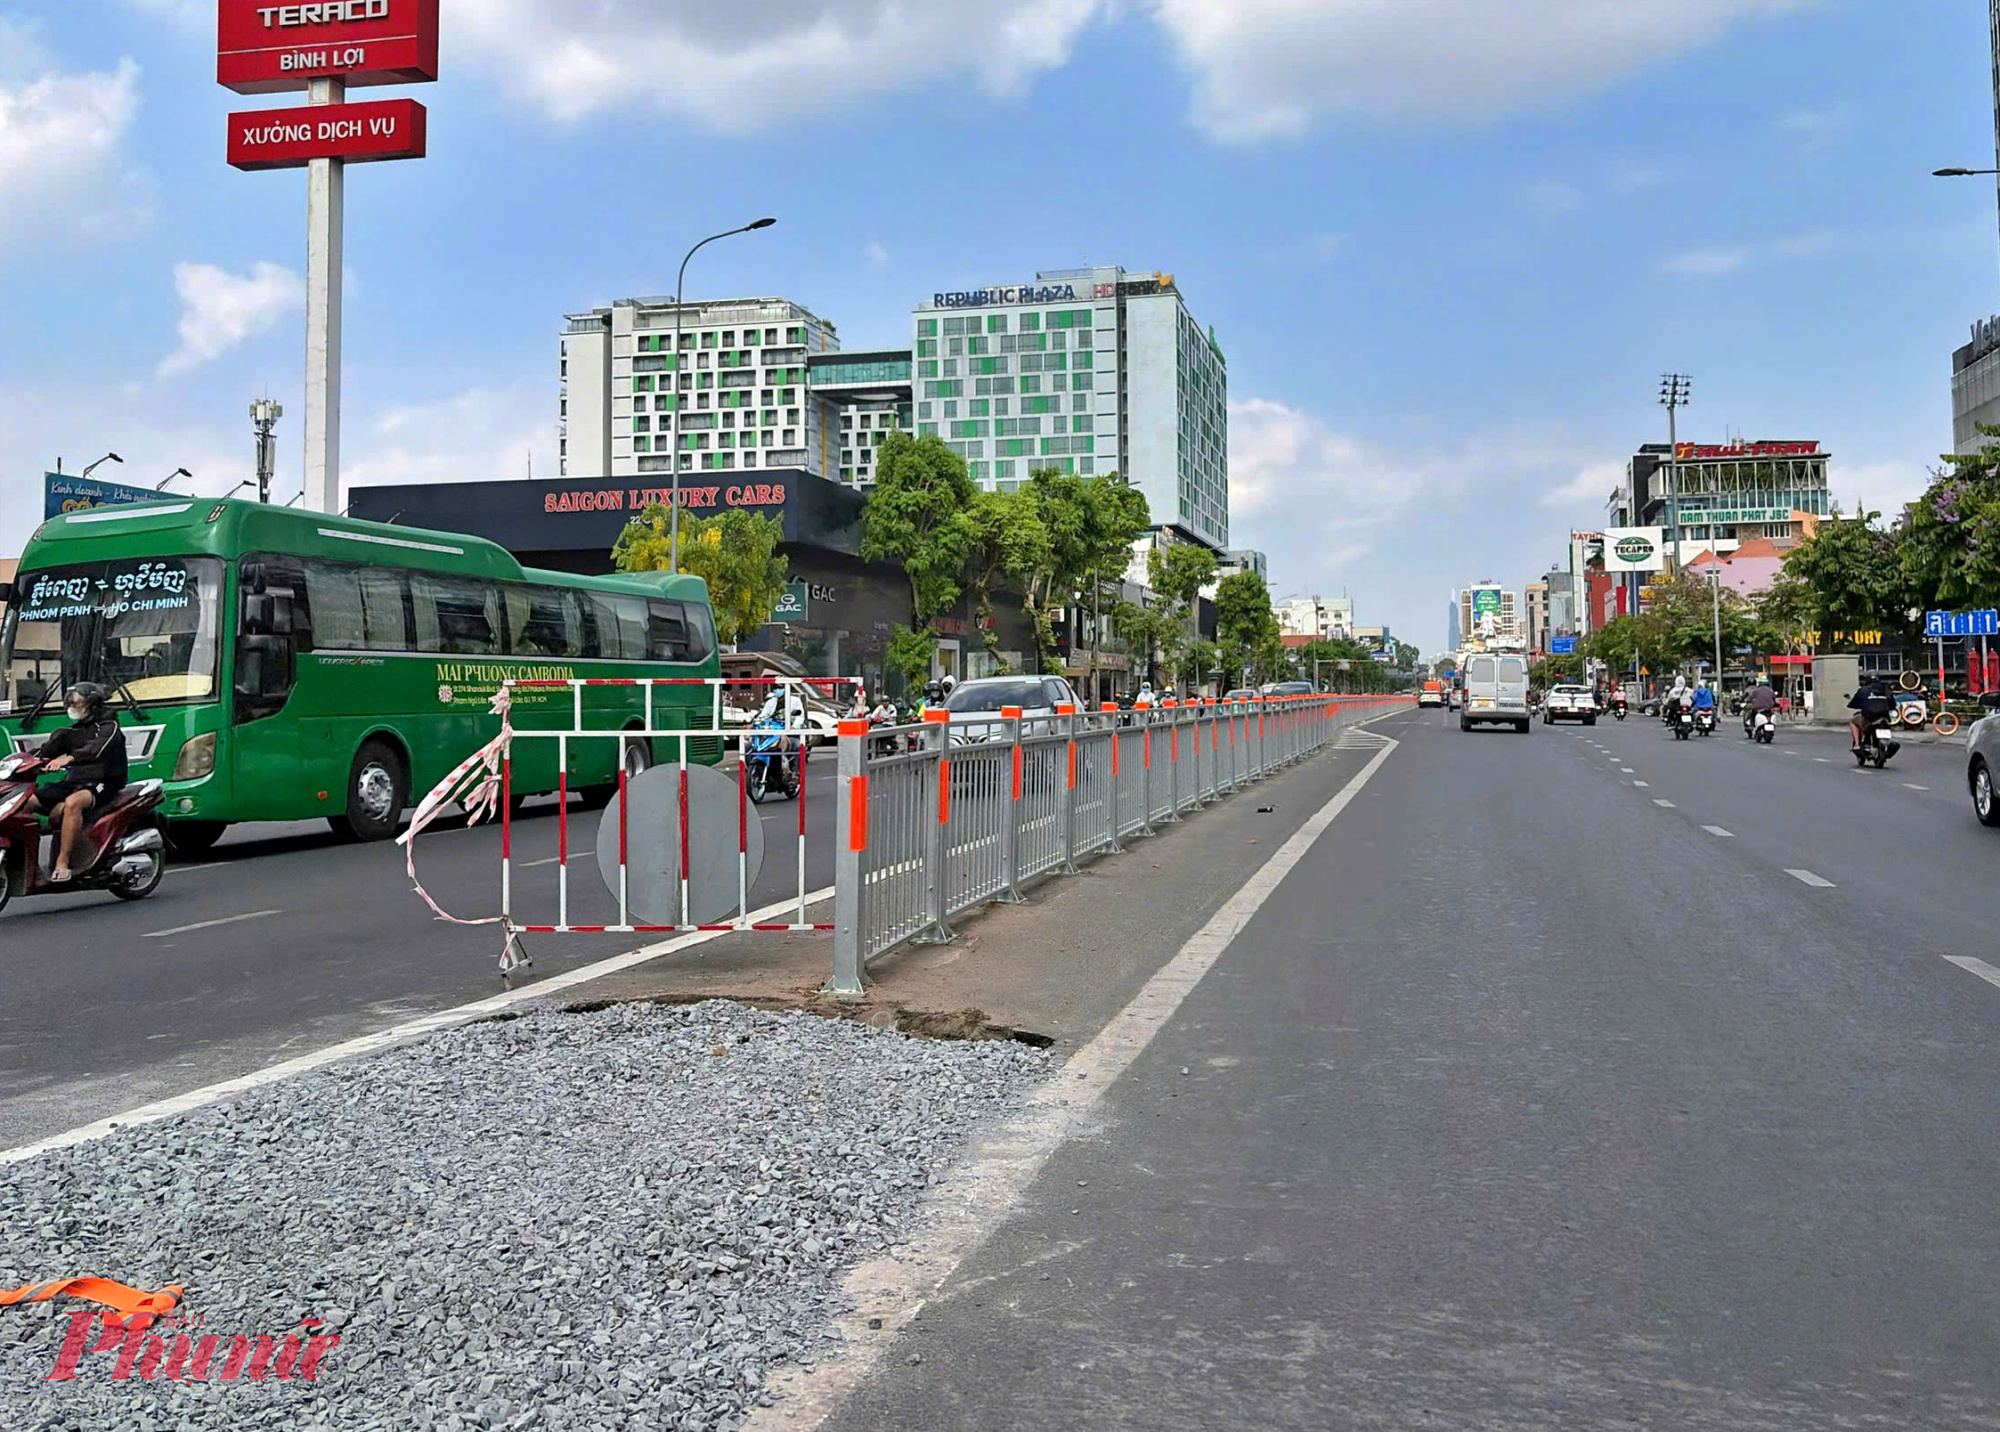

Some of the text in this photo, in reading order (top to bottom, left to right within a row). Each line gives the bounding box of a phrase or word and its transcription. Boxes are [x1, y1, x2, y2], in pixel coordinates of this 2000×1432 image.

[256, 0, 389, 27] TERACO
[280, 48, 364, 71] BÌNH LỢI
[243, 117, 396, 146] XƯỞNG DỊCH VỤ
[933, 284, 1076, 309] REPUBLIC PLAZA
[543, 484, 786, 513] SAIGON LUXURY CARS
[1679, 511, 1704, 524] NAM
[1769, 508, 1789, 521] JSC
[1613, 545, 1655, 554] TECAPRO
[811, 584, 837, 602] GAC
[19, 607, 58, 622] PHNOM
[59, 604, 91, 618] PENH
[131, 599, 154, 612] CHI
[156, 597, 189, 609] MINH
[775, 603, 802, 612] GAC
[437, 664, 462, 681] MAI
[518, 665, 575, 681] CAMBODIA
